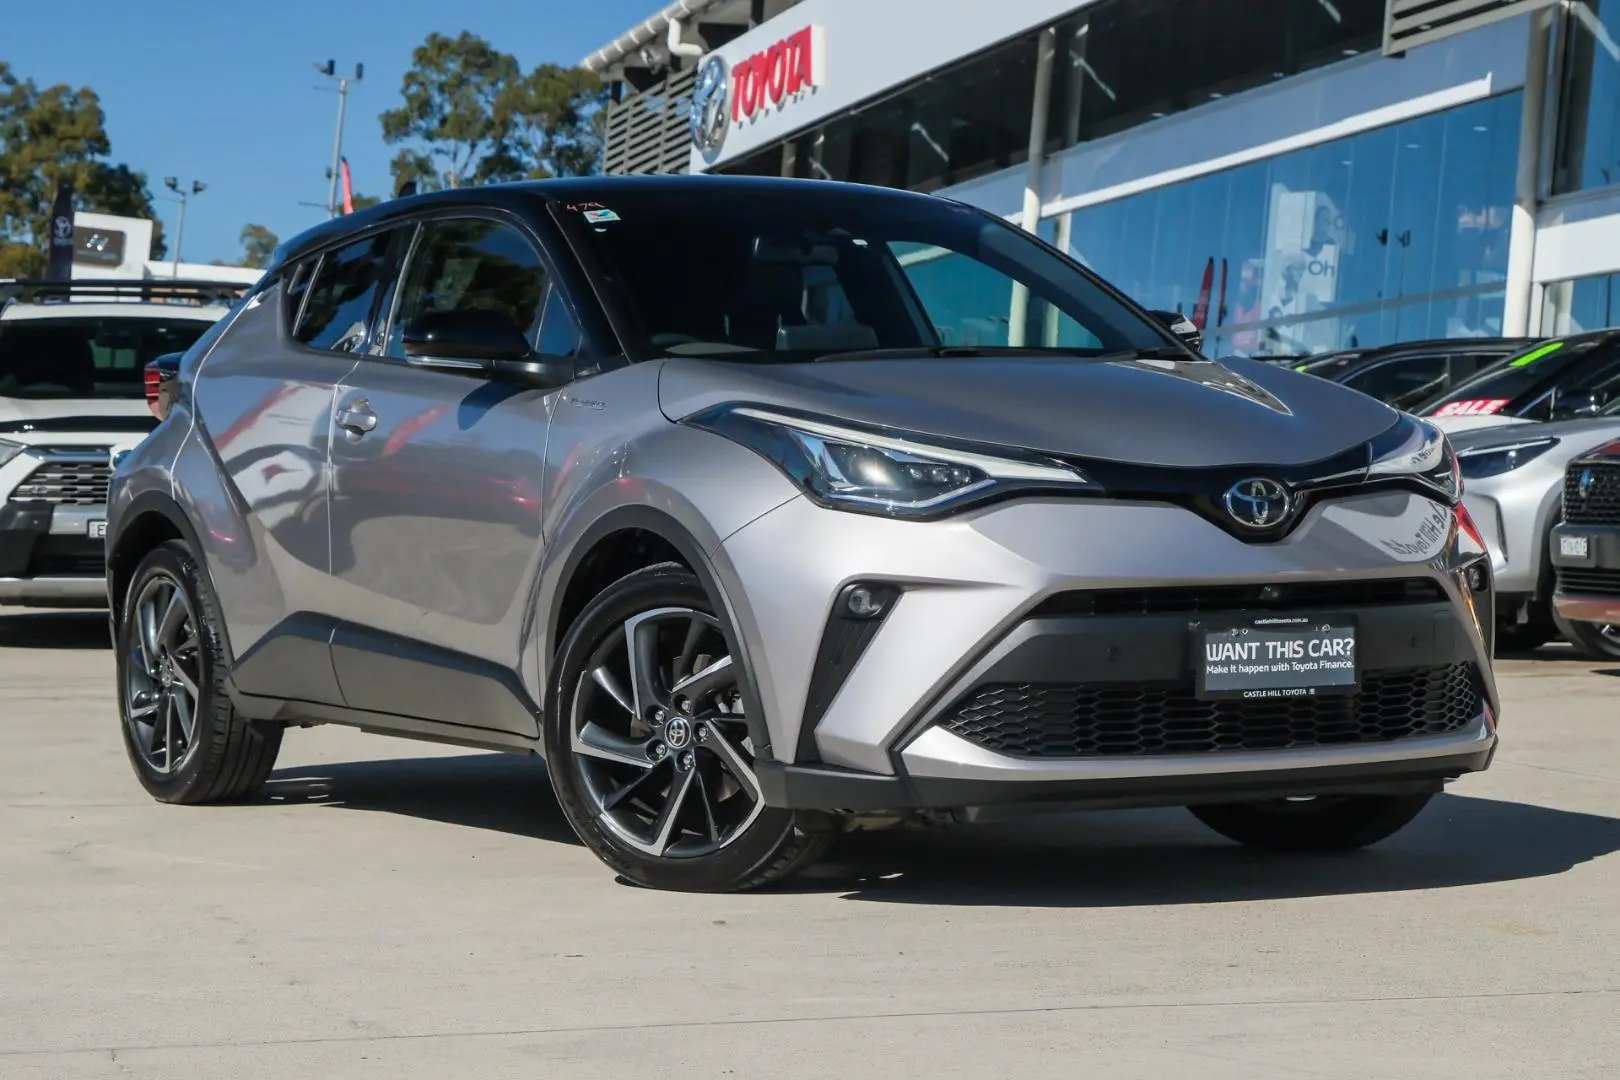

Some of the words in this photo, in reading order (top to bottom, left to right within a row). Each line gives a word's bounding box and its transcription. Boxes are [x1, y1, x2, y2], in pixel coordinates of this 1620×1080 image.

[732, 24, 813, 122] TOYOTA
[1436, 399, 1506, 417] SALE
[1205, 642, 1261, 662] WANT
[1264, 640, 1304, 659] THIS
[1308, 637, 1355, 658] CAR?
[1206, 664, 1229, 675] Make
[1230, 664, 1238, 673] it
[1238, 664, 1269, 675] happen
[1271, 662, 1290, 672] with
[1291, 661, 1318, 673] Toyota
[1319, 660, 1354, 670] Finance.
[1243, 690, 1267, 698] CASTLE
[1282, 688, 1307, 697] TOYOTA
